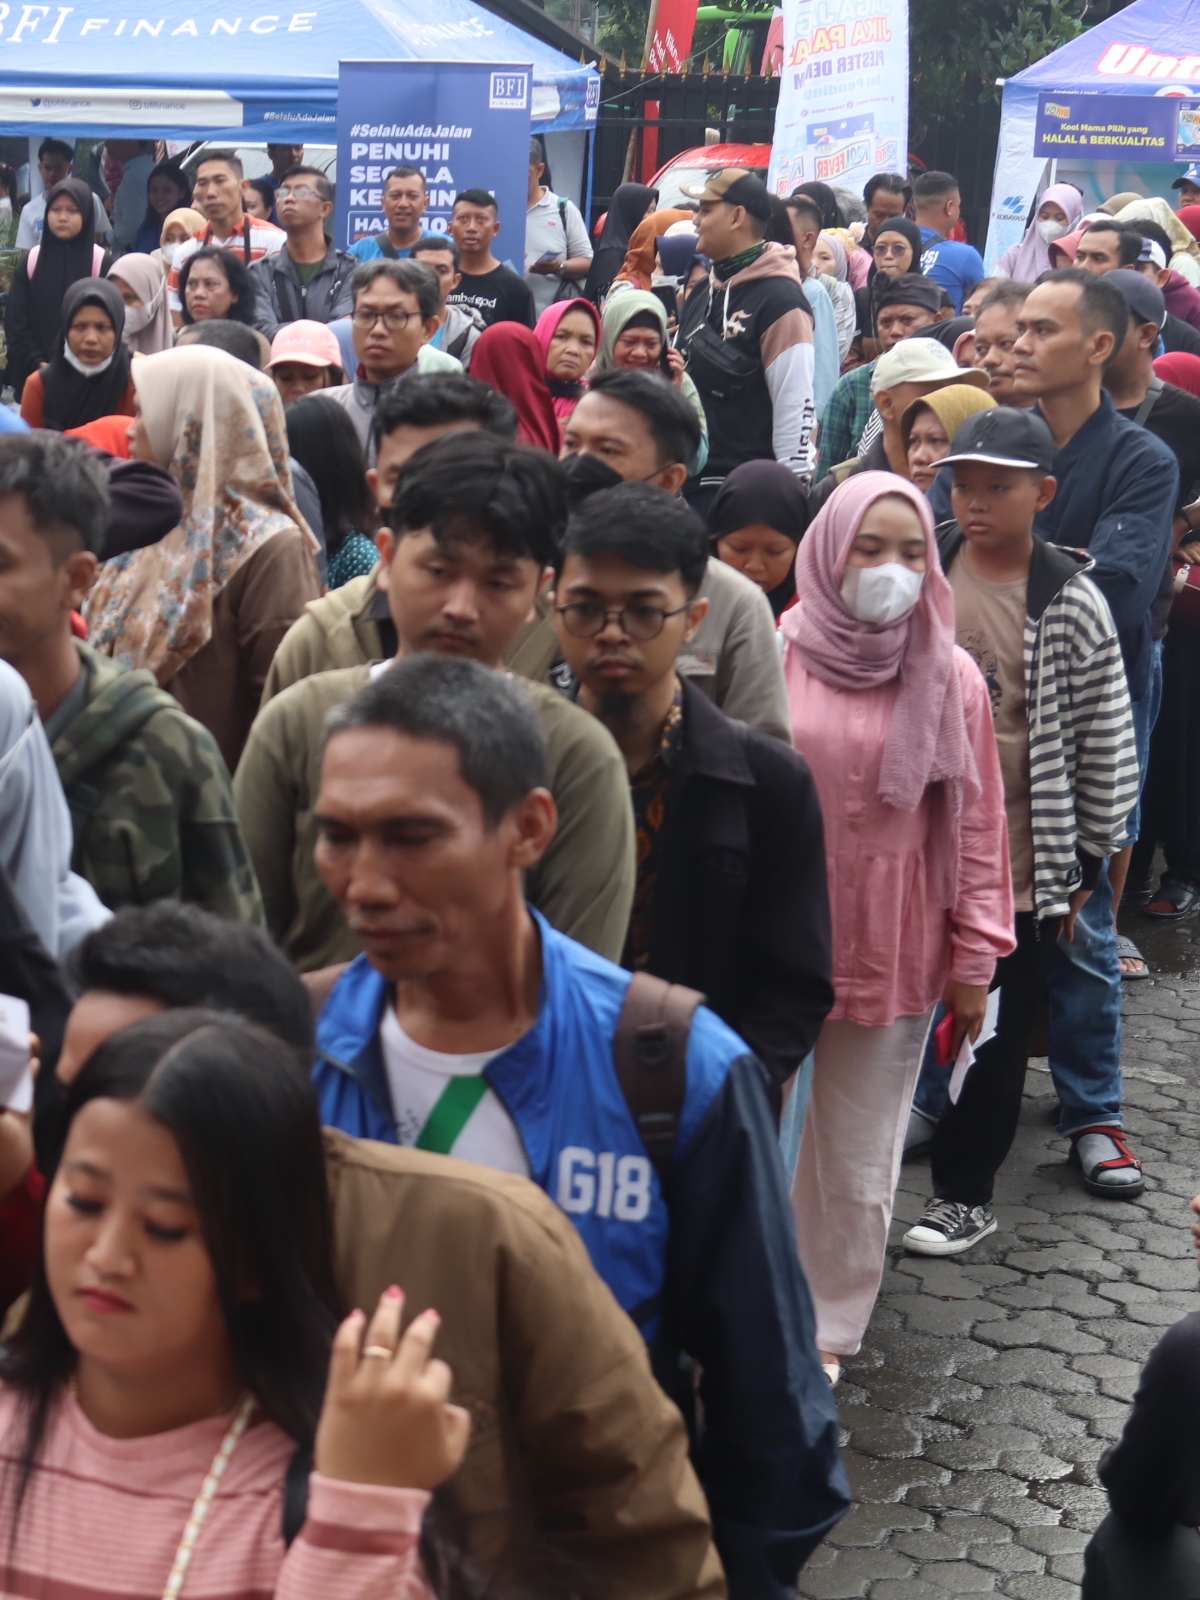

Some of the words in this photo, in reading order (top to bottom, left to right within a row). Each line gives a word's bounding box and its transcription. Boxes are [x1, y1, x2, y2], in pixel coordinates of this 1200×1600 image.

[79, 12, 318, 37] FINANCE
[495, 78, 523, 97] BFI
[350, 124, 473, 139] #SelaluAdaJalan
[1061, 123, 1079, 132] Kool
[1081, 124, 1106, 132] Mama
[1107, 125, 1127, 133] Pilih
[1127, 126, 1149, 136] yang
[1042, 134, 1078, 145] HALAL
[1079, 135, 1088, 145] &
[1090, 135, 1166, 147] BERKUALITAS
[351, 142, 450, 160] PENUHI
[350, 166, 454, 183] SELA
[446, 292, 467, 303] amb
[557, 1145, 651, 1222] G18
